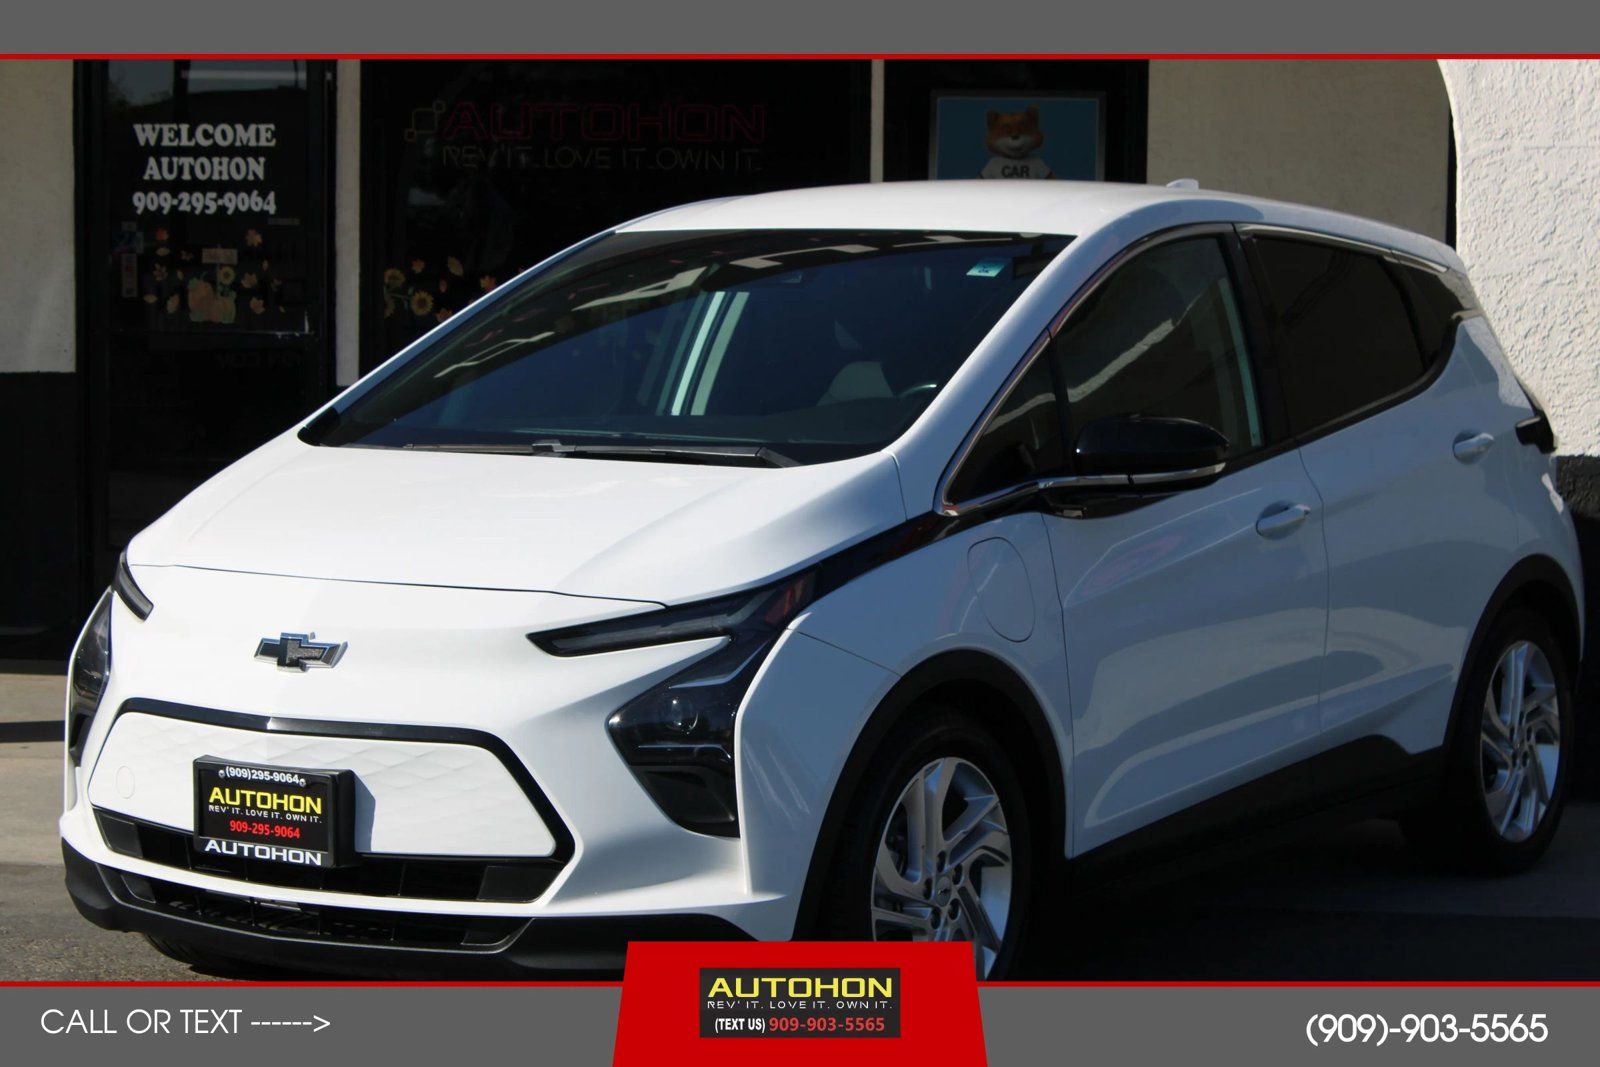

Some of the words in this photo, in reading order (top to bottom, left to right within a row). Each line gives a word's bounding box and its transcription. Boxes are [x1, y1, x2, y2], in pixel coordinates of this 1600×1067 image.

[441, 101, 768, 144] AUTOHON
[133, 123, 276, 147] WELCOME
[143, 156, 266, 181] AUTOHON
[544, 146, 611, 169] LOVE
[656, 147, 725, 170] OWN
[1001, 164, 1030, 178] CAR
[132, 190, 277, 215] 909-295-9064
[225, 766, 300, 785] (909)295-9064
[208, 787, 322, 814] AUTOHON
[246, 809, 268, 818] LOVE
[286, 813, 307, 822] OWN
[229, 819, 301, 839] 909-295-9064
[204, 840, 322, 866] AUTOHON
